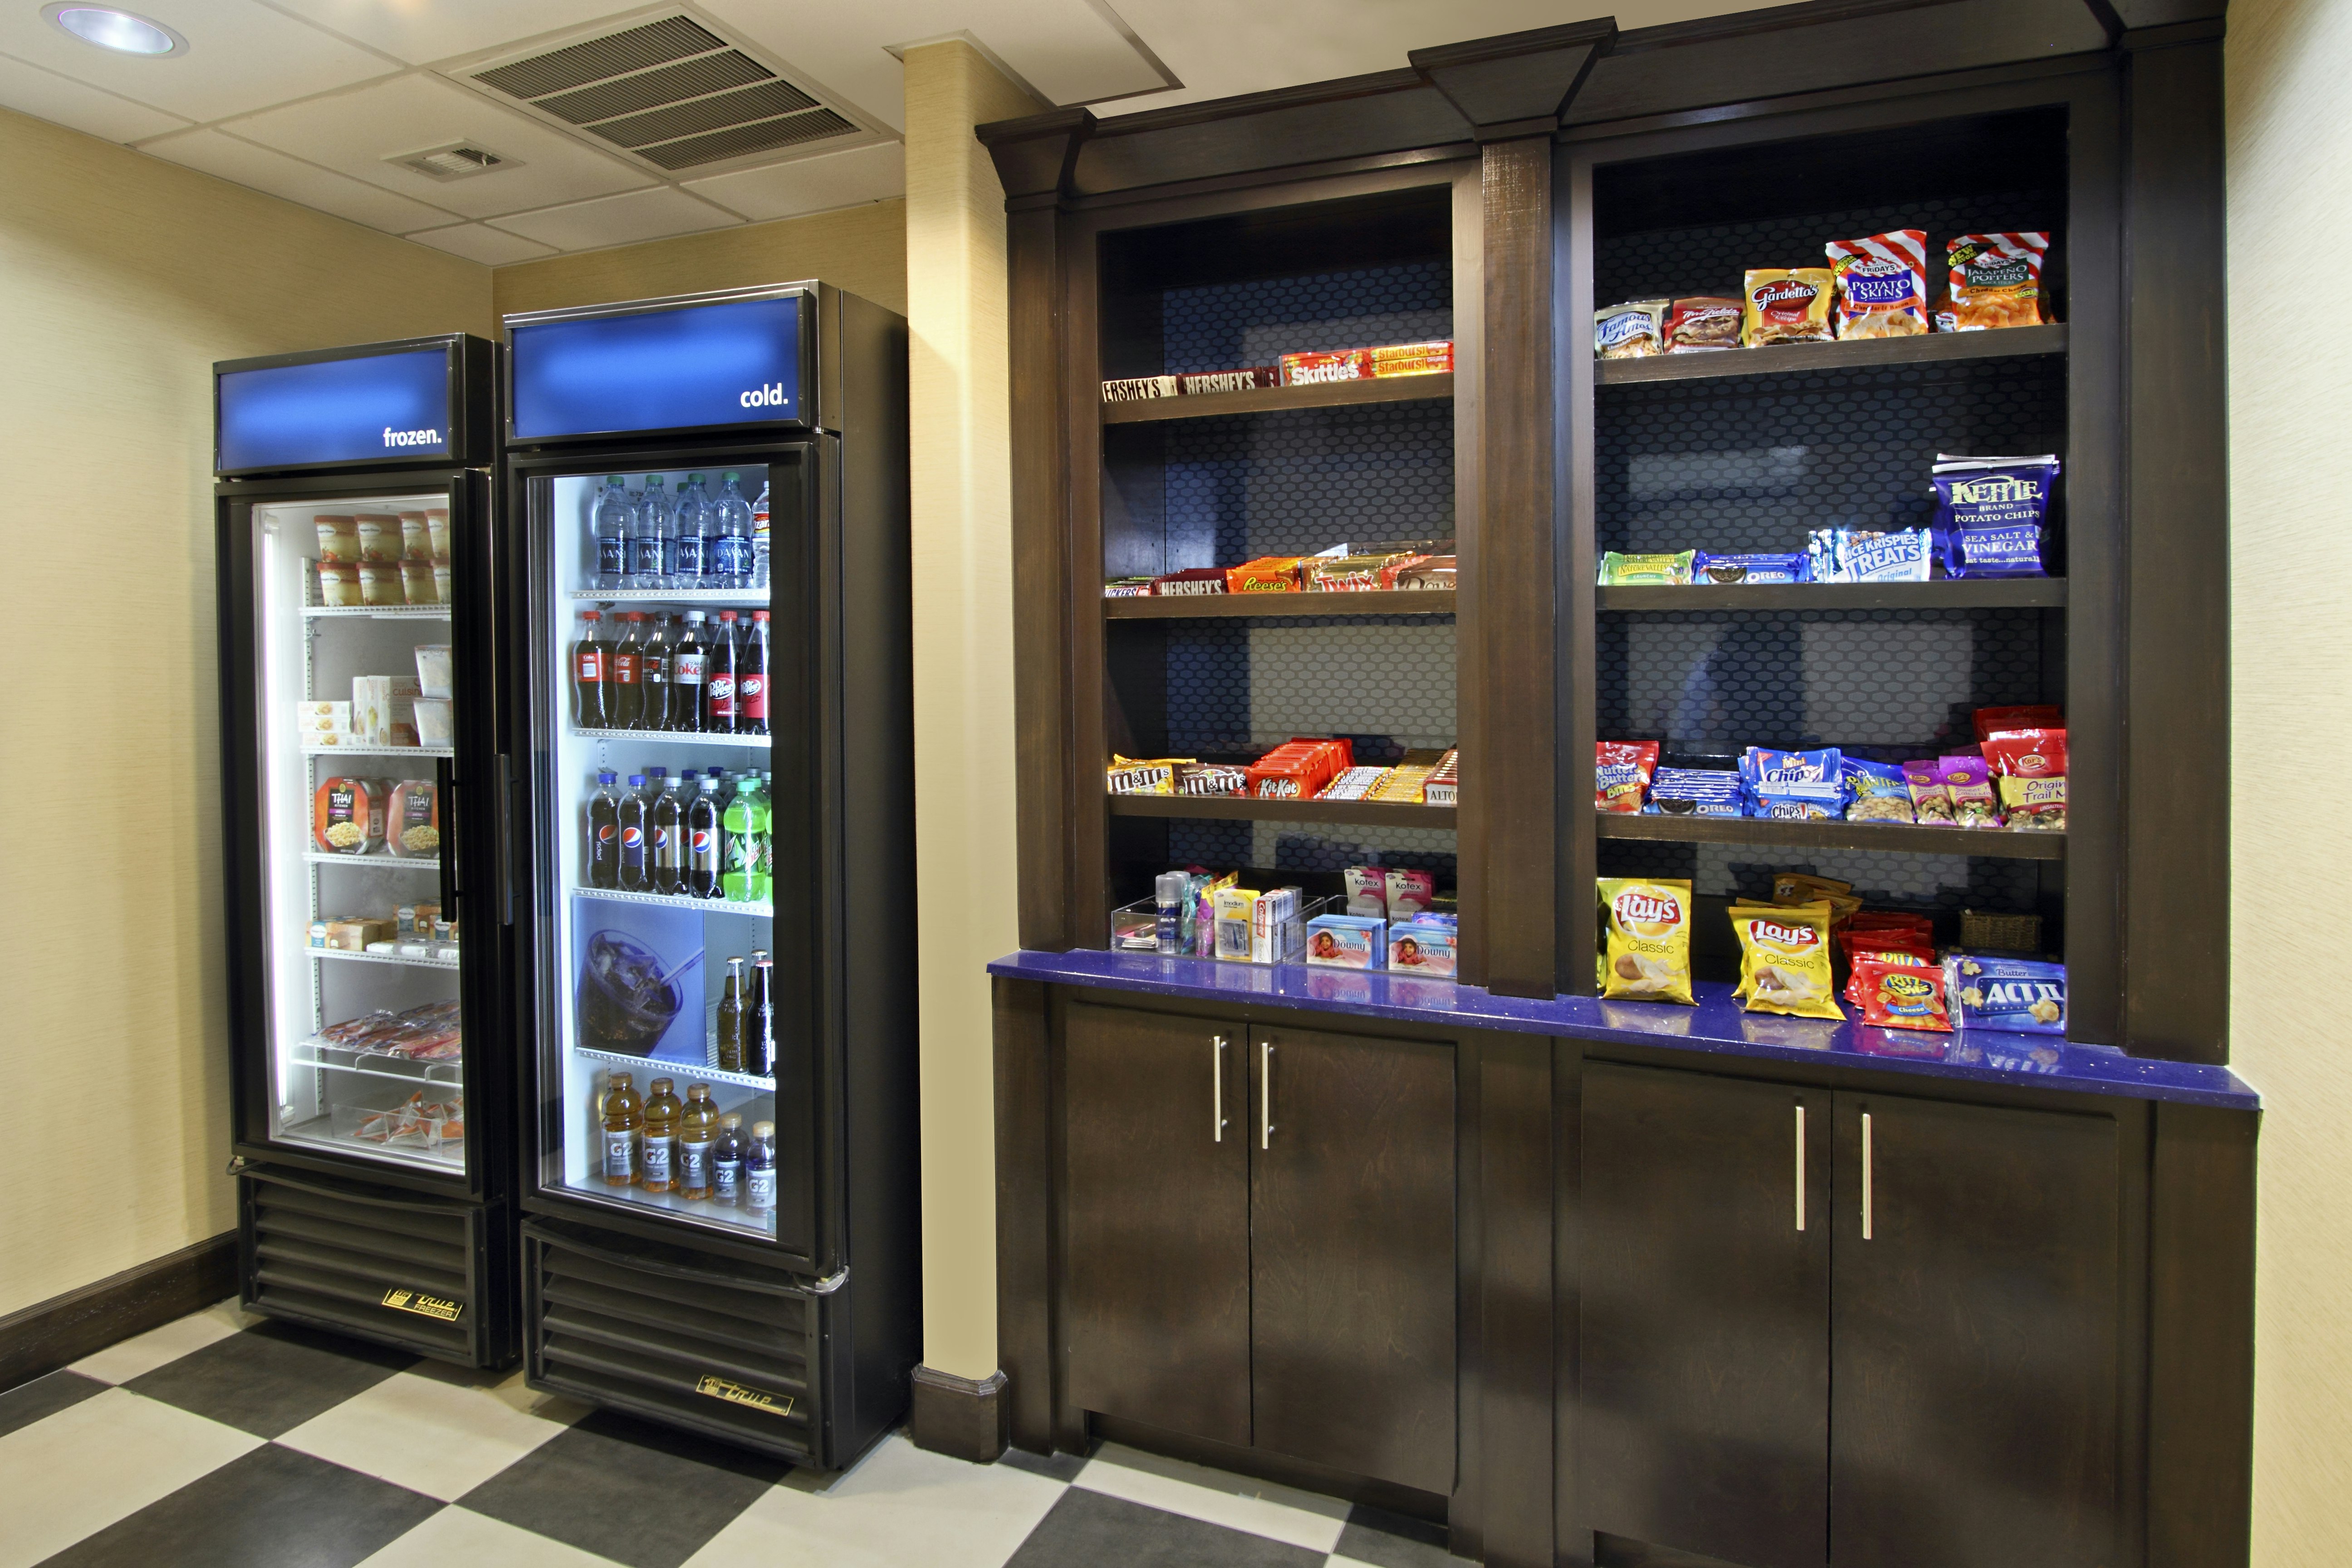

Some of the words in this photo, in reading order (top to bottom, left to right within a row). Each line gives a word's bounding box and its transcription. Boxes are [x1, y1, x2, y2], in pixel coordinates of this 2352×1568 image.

[1948, 245, 1974, 265] NEW
[1852, 279, 1911, 291] POTATO
[1972, 273, 2024, 283] POPPERS
[1751, 284, 1819, 312] Gardetto's
[1860, 288, 1903, 299] SKINS
[1597, 313, 1651, 339] Famous
[1609, 322, 1653, 342] Amos
[1607, 339, 1632, 350] Chocolate
[1632, 333, 1643, 342] Chip
[1378, 346, 1425, 359] Starburst
[1378, 359, 1425, 372] Starburst
[1291, 364, 1359, 386] Skittles
[1103, 378, 1161, 402] ERSHEY'S
[1184, 372, 1255, 395] HERSHEY'S
[740, 383, 788, 407] cold.
[383, 427, 442, 447] frozen.
[1948, 475, 2043, 505] KETTLE
[1979, 503, 2014, 512] BRAND
[1955, 513, 2001, 523] POTATO
[2004, 510, 2040, 519] CHIPS
[1990, 532, 2021, 541] SALT
[1844, 543, 1865, 561] RICE
[1865, 534, 1919, 552] KRISPIES
[1962, 540, 2038, 554] VINEGAR
[1620, 566, 1645, 574] NATURE
[1845, 544, 1921, 582] TREATS
[1746, 571, 1786, 583] OREO
[1877, 568, 1912, 582] Original
[1106, 588, 1137, 597] ICKERS
[1160, 579, 1222, 596] HERSHEY'S
[674, 663, 702, 675] Coke
[393, 686, 422, 696] cuisin
[709, 682, 734, 697] Pepper
[1782, 757, 1806, 769] Mini
[2022, 756, 2042, 764] Kar's
[1597, 763, 1638, 779] Nutter
[1598, 773, 1641, 789] Butter
[2027, 780, 2065, 791] Origin
[332, 793, 352, 804] THAI
[408, 796, 429, 807] THAI
[1430, 790, 1457, 801] ALTO
[2023, 791, 2051, 803] Trail
[1695, 805, 1734, 814] OREO
[1772, 803, 1800, 818] Chips
[1355, 878, 1379, 887] Kotex
[1396, 882, 1422, 890] Kotex
[1621, 894, 1676, 923] Lay's
[1756, 920, 1814, 945] Lay's
[1333, 937, 1366, 953] Downy
[1628, 940, 1674, 954] Classic
[1417, 945, 1450, 960] Downy
[1765, 954, 1814, 969] Classic
[1996, 968, 2028, 977] Butter
[1887, 974, 1921, 986] RITZ
[1986, 983, 2035, 1004] ACT
[2034, 983, 2064, 1001] II
[610, 1141, 633, 1156] G2
[645, 1147, 669, 1164] G2
[681, 1153, 700, 1168] G2
[716, 1170, 734, 1183] G2
[749, 1179, 769, 1193] G2
[414, 1304, 453, 1318] FREEZER
